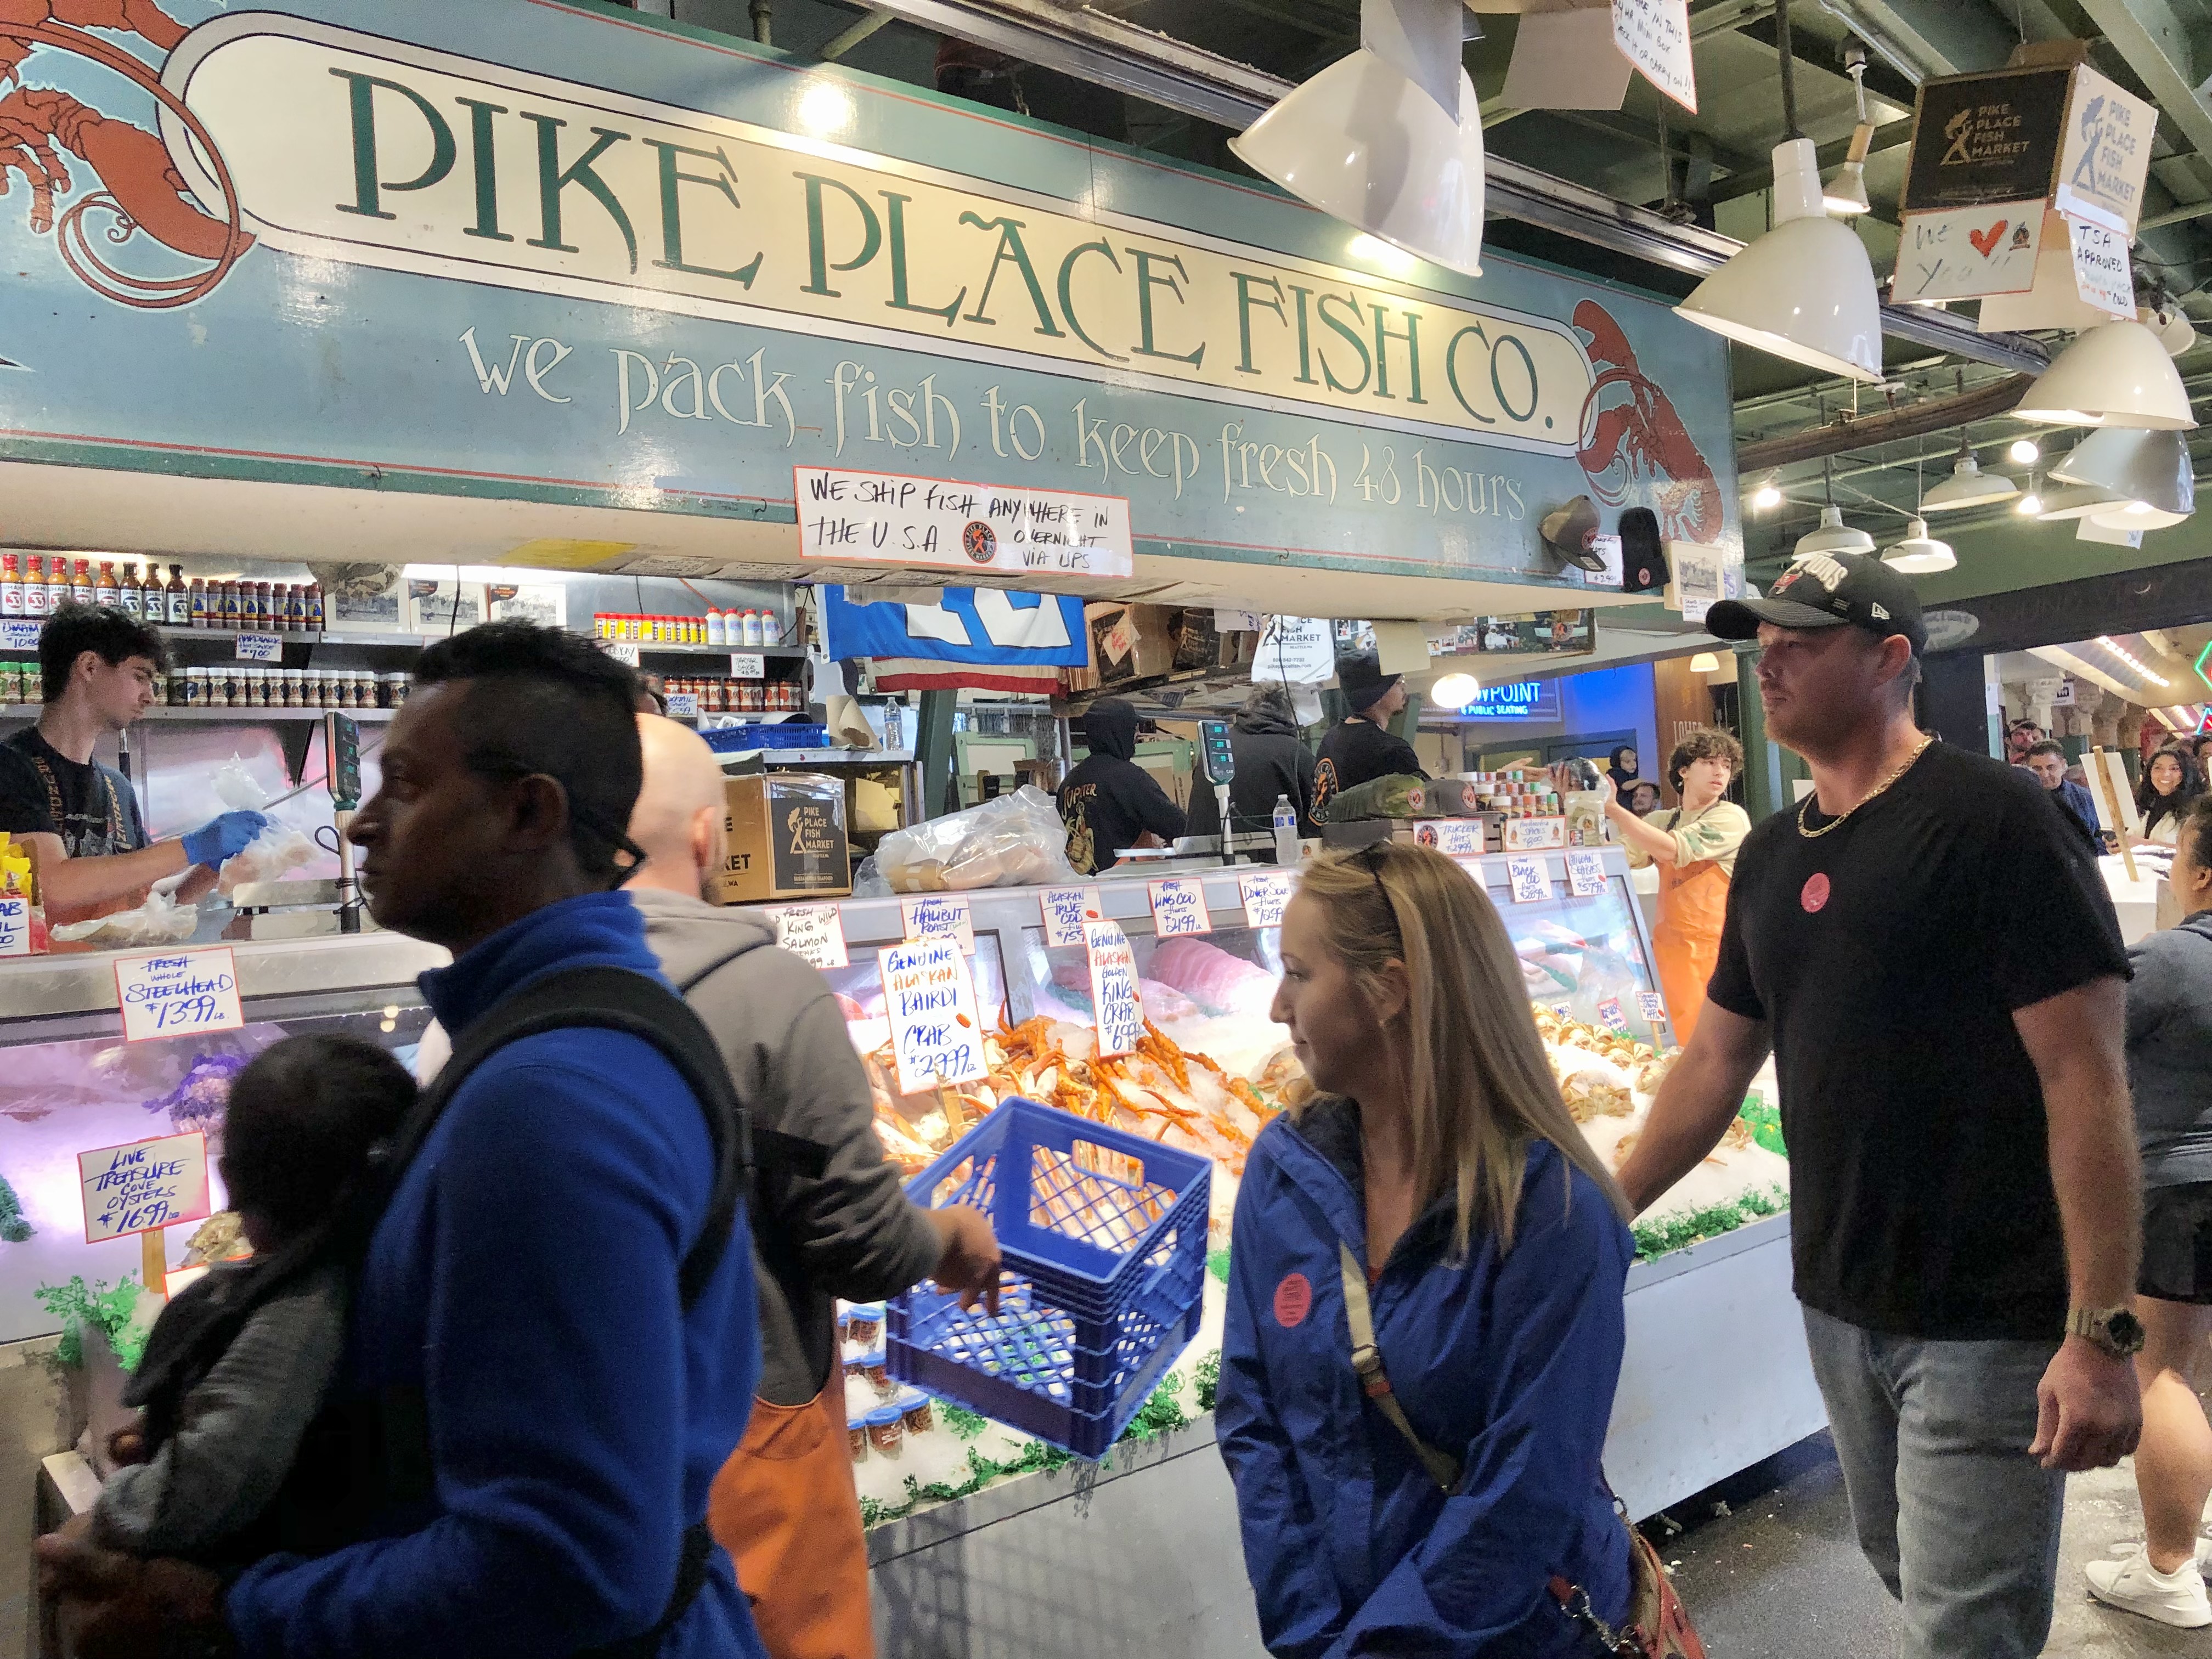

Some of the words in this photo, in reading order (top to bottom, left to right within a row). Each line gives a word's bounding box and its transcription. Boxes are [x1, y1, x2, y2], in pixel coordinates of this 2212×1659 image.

[1665, 19, 1683, 44] THIS
[1650, 57, 1671, 86] CARRY
[1978, 104, 2010, 116] PIKE
[2109, 100, 2132, 127] PIKE
[1976, 115, 2022, 130] PLACE
[1974, 131, 2005, 144] FISH
[2105, 122, 2136, 156] PLACE
[1972, 140, 2030, 156] MARKET
[2100, 145, 2124, 172] FISH
[2097, 170, 2136, 203] MARKET
[2078, 225, 2111, 249] TSA
[328, 67, 764, 291] PIKE
[792, 171, 1206, 370] PLACE
[1229, 271, 1428, 405] FISH
[1445, 320, 1554, 430] CO.
[2076, 246, 2123, 273] APPROVED
[608, 346, 796, 449] pack
[824, 360, 961, 462] fish
[980, 385, 1045, 461] to
[1071, 397, 1200, 501] keep
[1216, 422, 1338, 506] fresh
[1354, 443, 1402, 505] 48
[1410, 448, 1526, 522] hours
[811, 472, 850, 501] WE
[988, 496, 1081, 524] ANYWHERE
[808, 515, 865, 546] THE
[1013, 529, 1108, 549] OVERNIGHT
[1059, 551, 1090, 569] UPS
[1281, 634, 1322, 642] MARKET
[1468, 705, 1496, 715] PUBLIC
[1496, 704, 1529, 715] SEATING
[803, 806, 820, 816] PIKE
[804, 817, 828, 828] PLACE
[1439, 824, 1480, 835] TRUCKER
[805, 829, 821, 838] FISH
[1447, 834, 1471, 844] HATS
[805, 839, 835, 849] MARKET
[1511, 864, 1539, 878] BLACK
[1046, 886, 1085, 904] ALASKAN
[1176, 891, 1197, 905] COD
[1243, 885, 1272, 902] DOVER
[1268, 882, 1290, 895] SOLE
[783, 906, 814, 918] FRESH
[1043, 901, 1085, 916] TRUE
[787, 920, 814, 935] KING
[921, 921, 956, 934] ROAST
[1060, 912, 1083, 925] COD
[782, 932, 828, 951] SALMON
[1090, 928, 1126, 949] GENUINE
[142, 955, 194, 972] FRESH
[887, 944, 953, 973] GENUINE
[1094, 949, 1131, 967] ALASKAN
[150, 970, 187, 983] WHOLE
[1102, 964, 1128, 980] GOLDEN
[125, 974, 234, 1003] STEELHEAD
[1102, 977, 1132, 1006] KING
[899, 986, 957, 1017] BAIRDI
[1103, 1001, 1136, 1025] CRAB
[904, 1023, 952, 1054] CRAB
[110, 1144, 157, 1171] LIVE
[84, 1158, 191, 1192] TREASURE
[120, 1179, 156, 1195] COVE
[106, 1185, 178, 1210] OYSTERS
